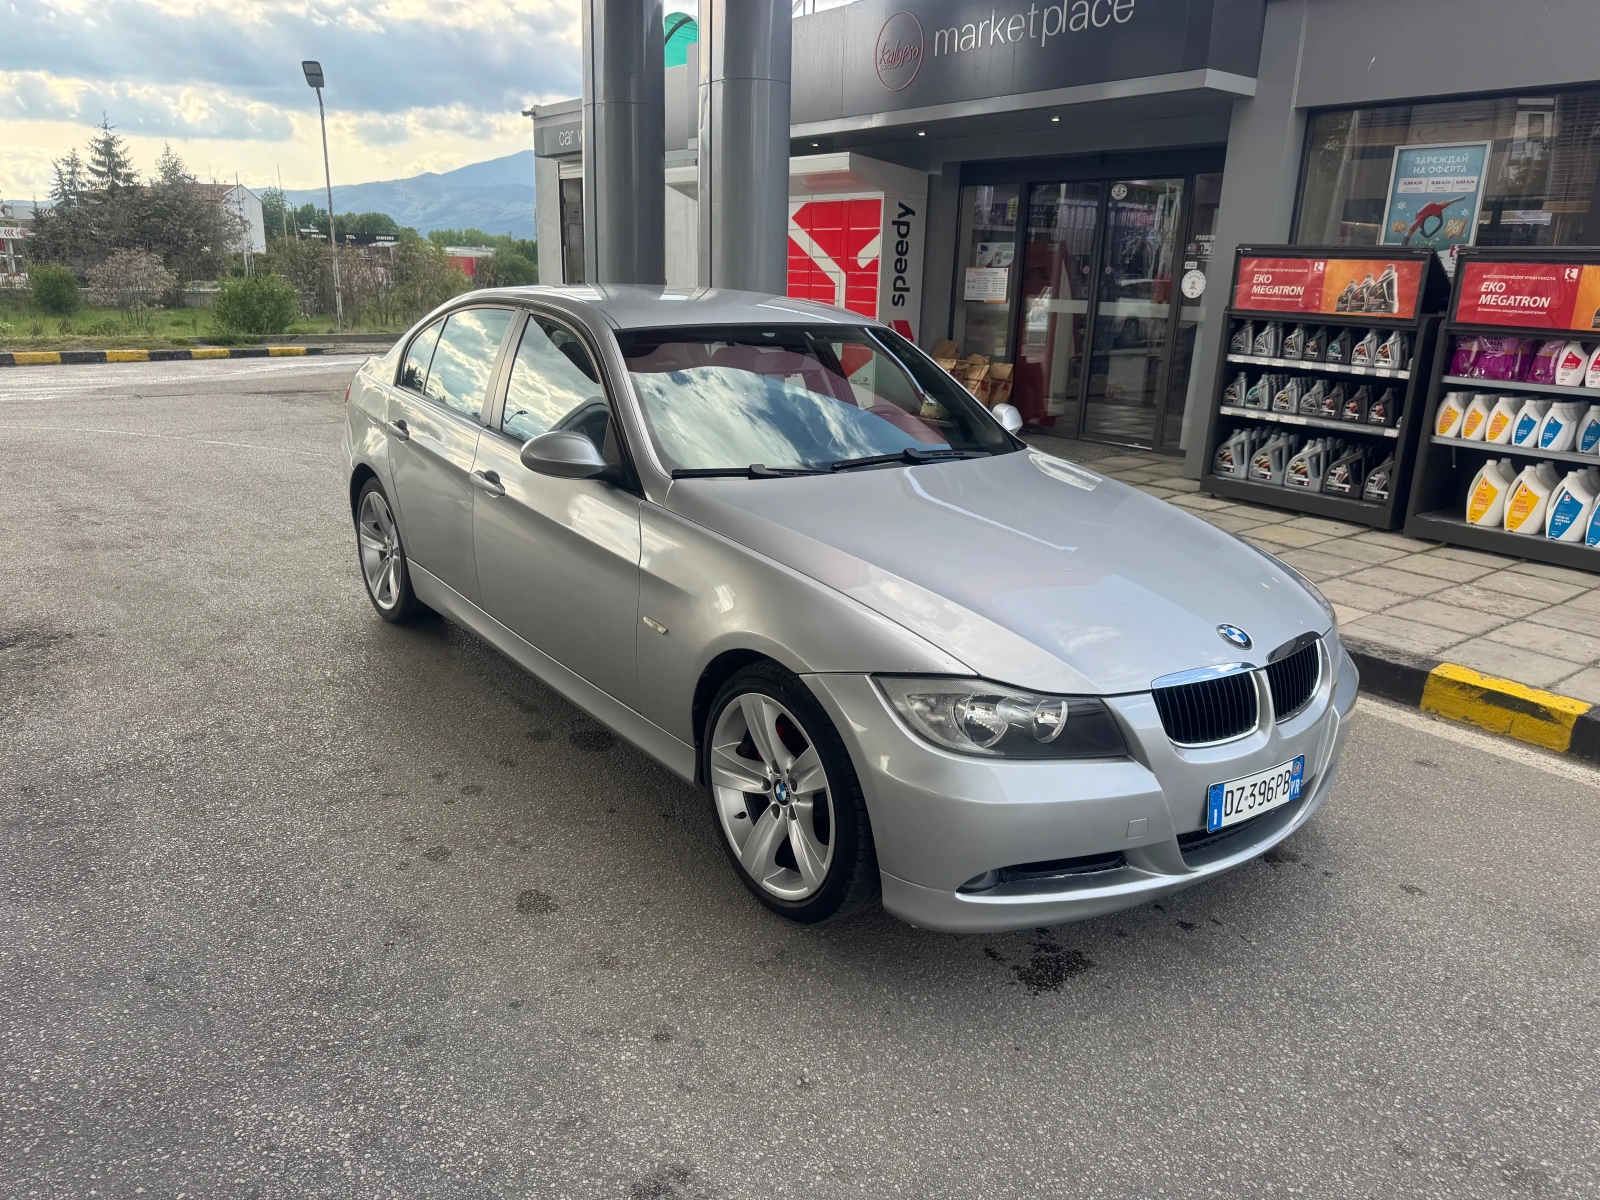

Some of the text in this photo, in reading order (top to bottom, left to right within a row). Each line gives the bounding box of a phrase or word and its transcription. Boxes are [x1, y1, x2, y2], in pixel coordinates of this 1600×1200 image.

[559, 130, 574, 146] car
[1415, 153, 1469, 165] ЗАРЕЖДАЙ
[1413, 165, 1467, 174] НА ОФЕРТА
[892, 202, 916, 307] speedy
[1252, 274, 1273, 284] EKO
[1251, 285, 1305, 296] MEGATRON
[1480, 281, 1506, 293] EKO
[1478, 294, 1551, 308] MEGATRON
